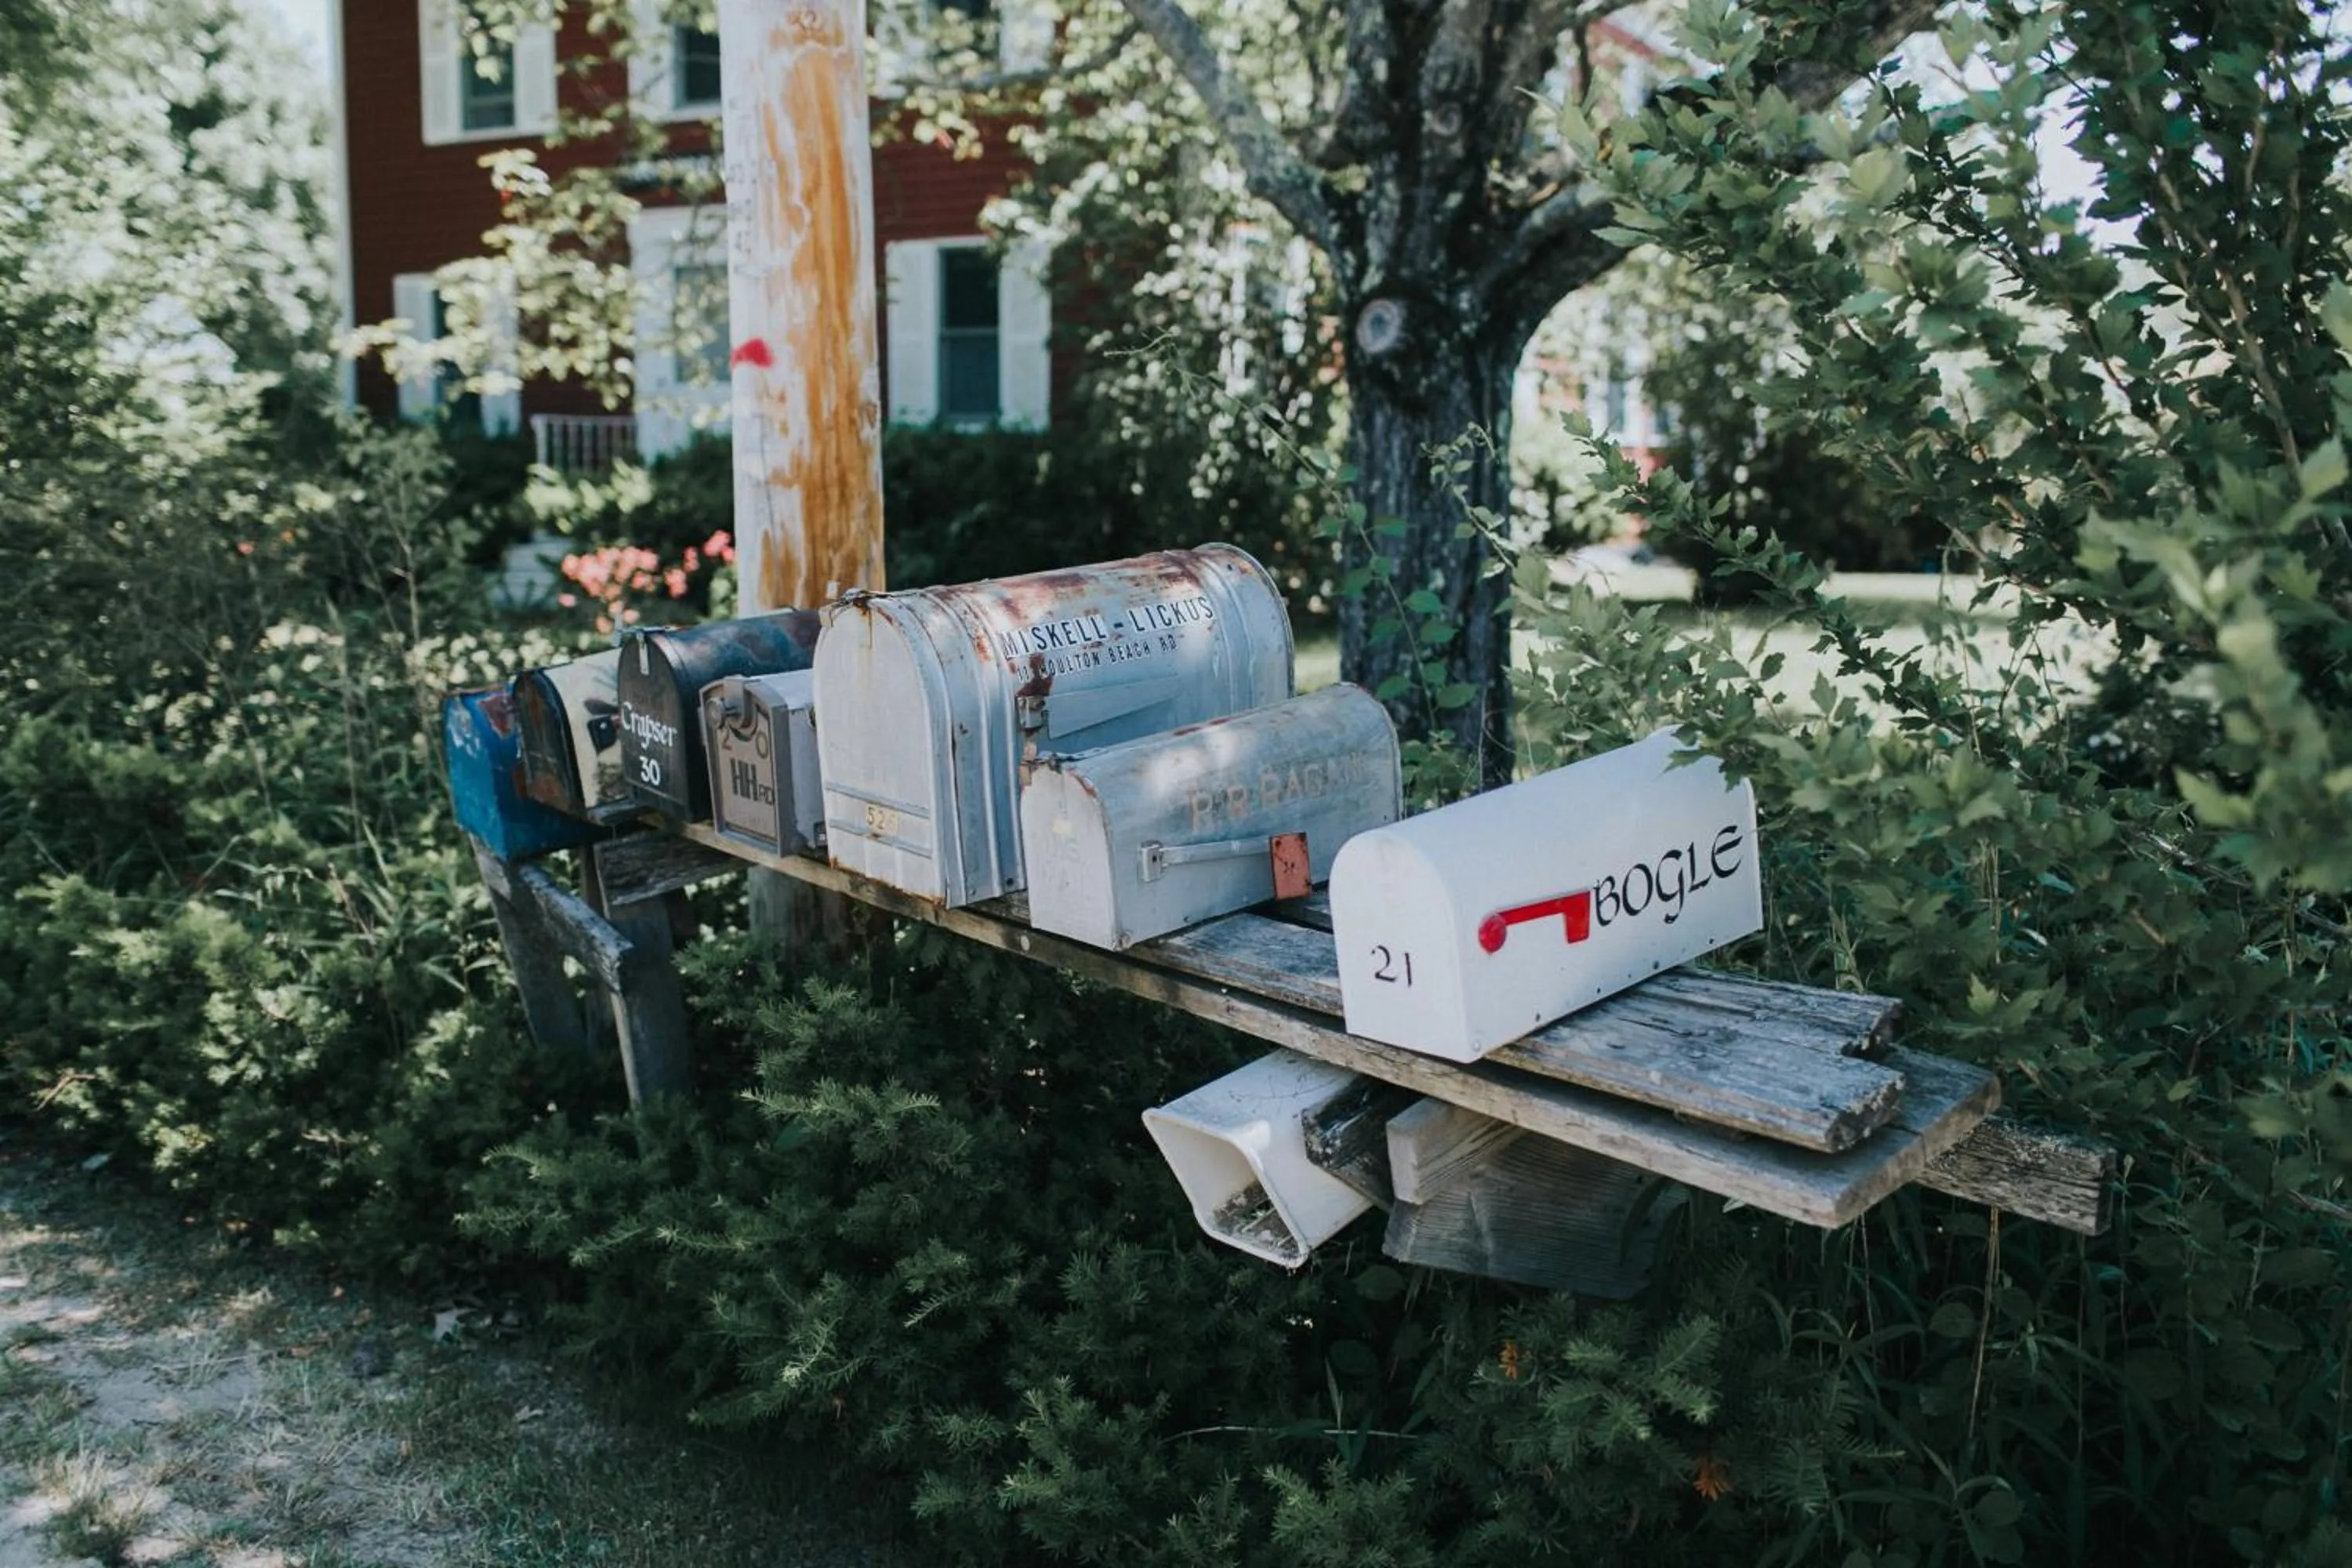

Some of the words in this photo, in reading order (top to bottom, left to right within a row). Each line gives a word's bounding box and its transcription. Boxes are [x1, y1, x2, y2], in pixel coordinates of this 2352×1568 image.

[1003, 616, 1107, 659] MISKELL
[1128, 597, 1214, 632] LICKUS
[1108, 641, 1150, 662] BEACH
[639, 755, 660, 786] 30
[1592, 824, 1744, 924] BOGLE
[1370, 945, 1413, 987] 21
